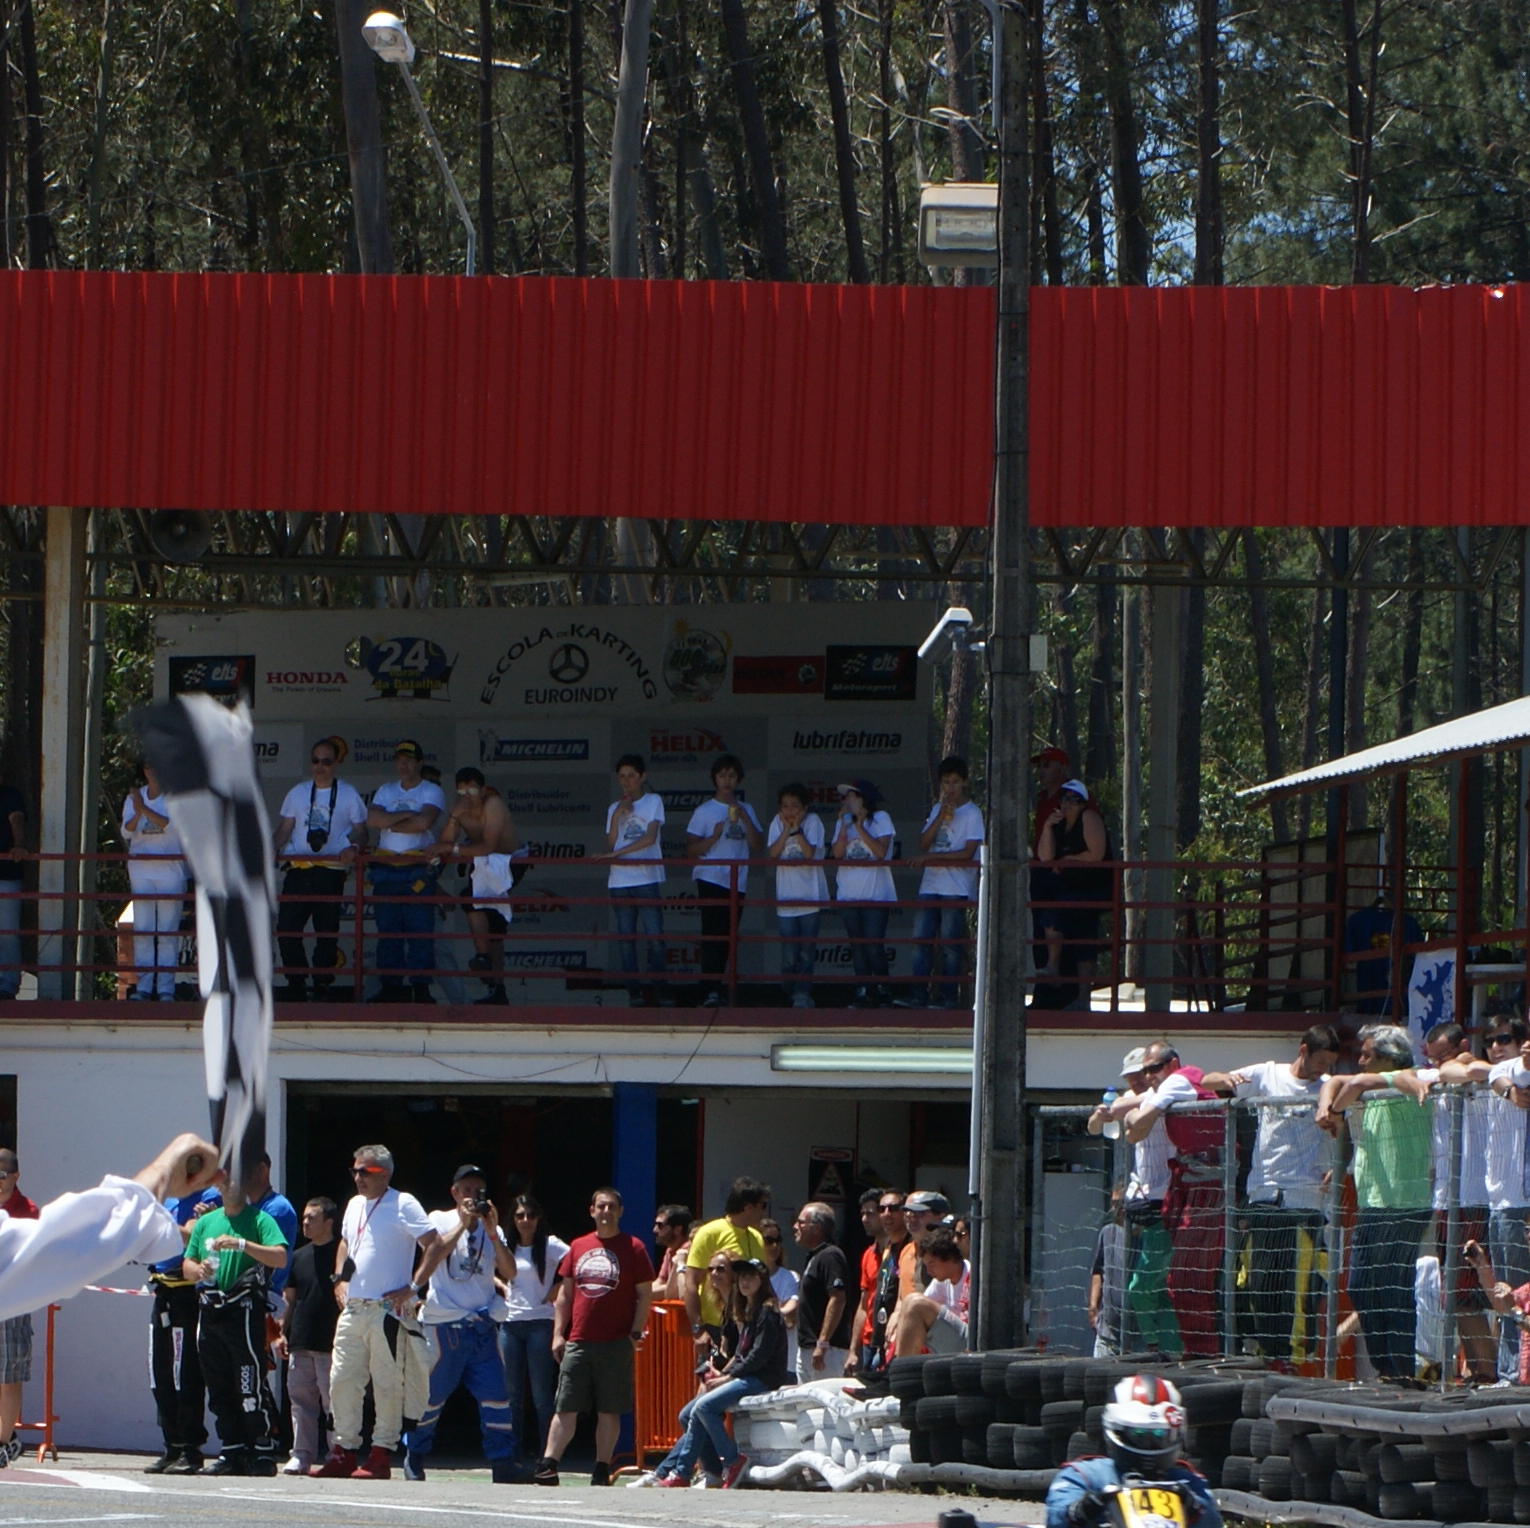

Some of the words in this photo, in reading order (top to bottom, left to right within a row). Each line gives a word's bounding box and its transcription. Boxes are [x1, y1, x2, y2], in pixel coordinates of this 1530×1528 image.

[378, 640, 429, 673] 24
[481, 627, 553, 705] ESCOLA
[570, 623, 658, 700] KARTING
[266, 672, 349, 685] HONDA
[525, 687, 619, 704] EUROINDY
[500, 742, 586, 756] MICHELIN
[650, 736, 726, 752] HELIX
[793, 731, 902, 750] lubrifatima
[508, 803, 533, 813] Shell
[536, 803, 591, 813] Lubricants
[528, 841, 586, 858] fatima
[241, 1365, 252, 1394] JOGOS
